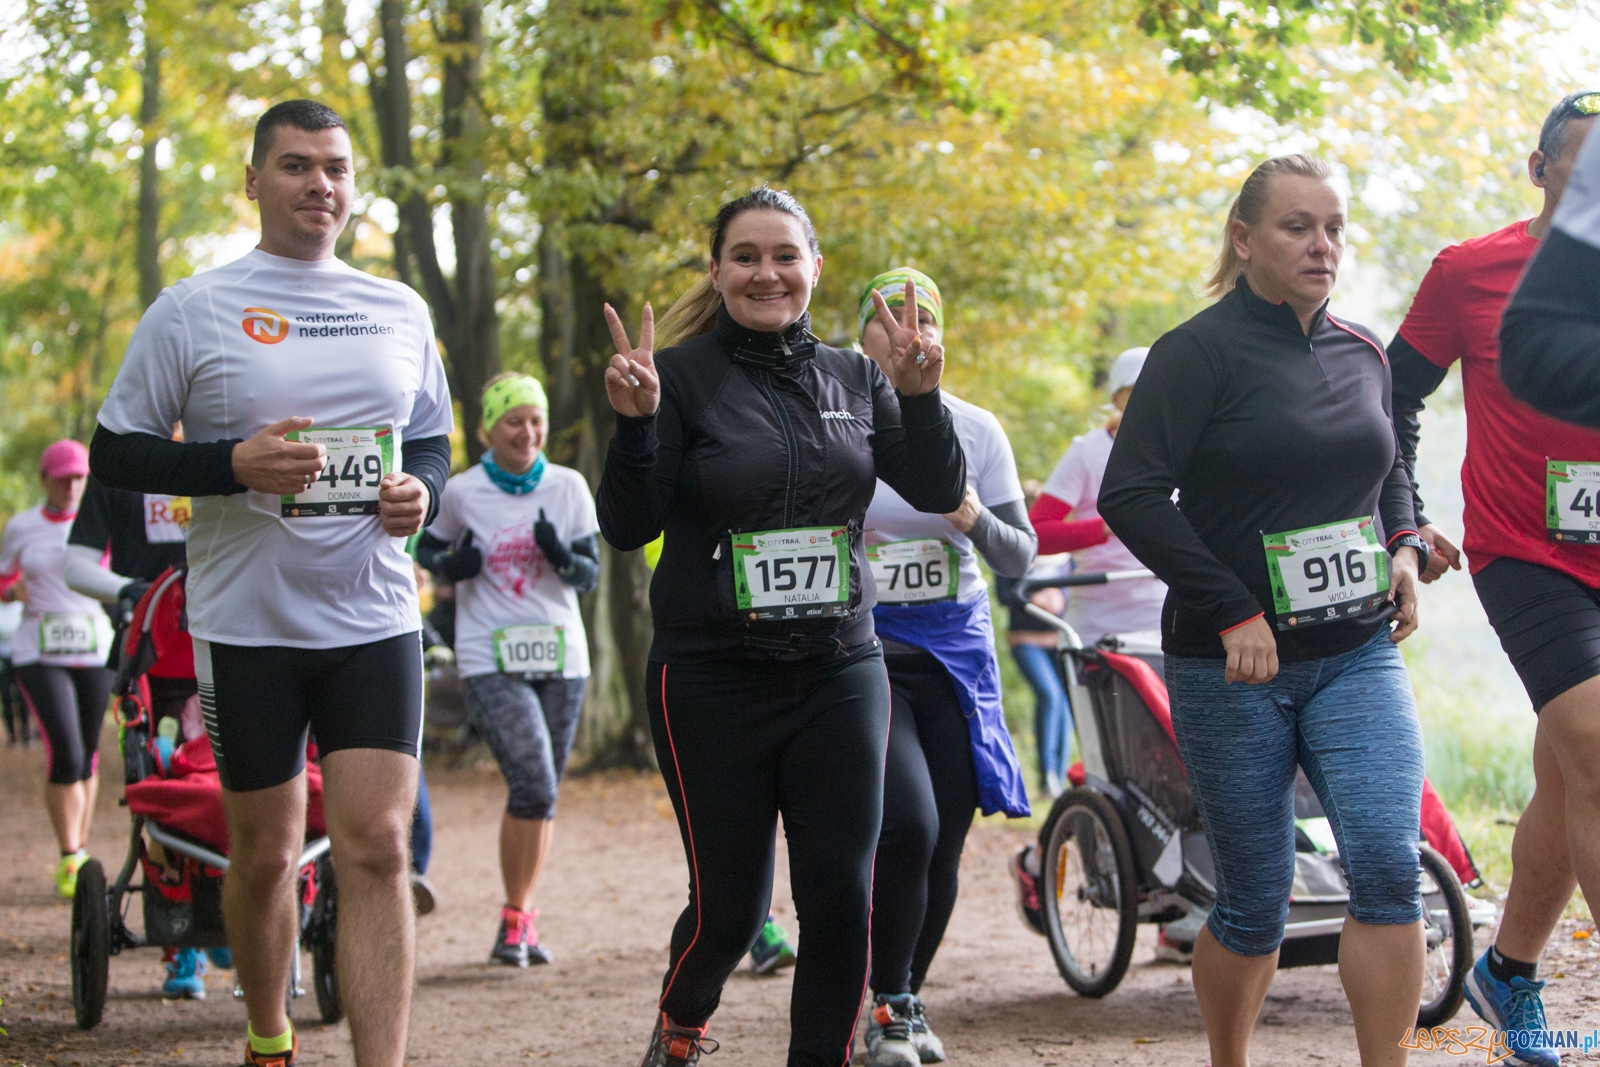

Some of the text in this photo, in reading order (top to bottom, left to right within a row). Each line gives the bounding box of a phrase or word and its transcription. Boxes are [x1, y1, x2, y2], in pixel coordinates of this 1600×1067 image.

[296, 312, 368, 324] nationale
[299, 324, 395, 337] nederlanden
[306, 455, 382, 489] 449
[327, 492, 362, 501] DOMINIK
[1569, 487, 1600, 518] 4
[1588, 521, 1600, 530] SZ
[755, 555, 837, 593] 1577
[883, 560, 943, 590] 706
[1303, 549, 1366, 593] 916
[784, 593, 820, 603] NATALIA
[904, 591, 927, 600] EDYTA
[1327, 589, 1356, 603] WIOLA
[505, 641, 558, 662] 1008
